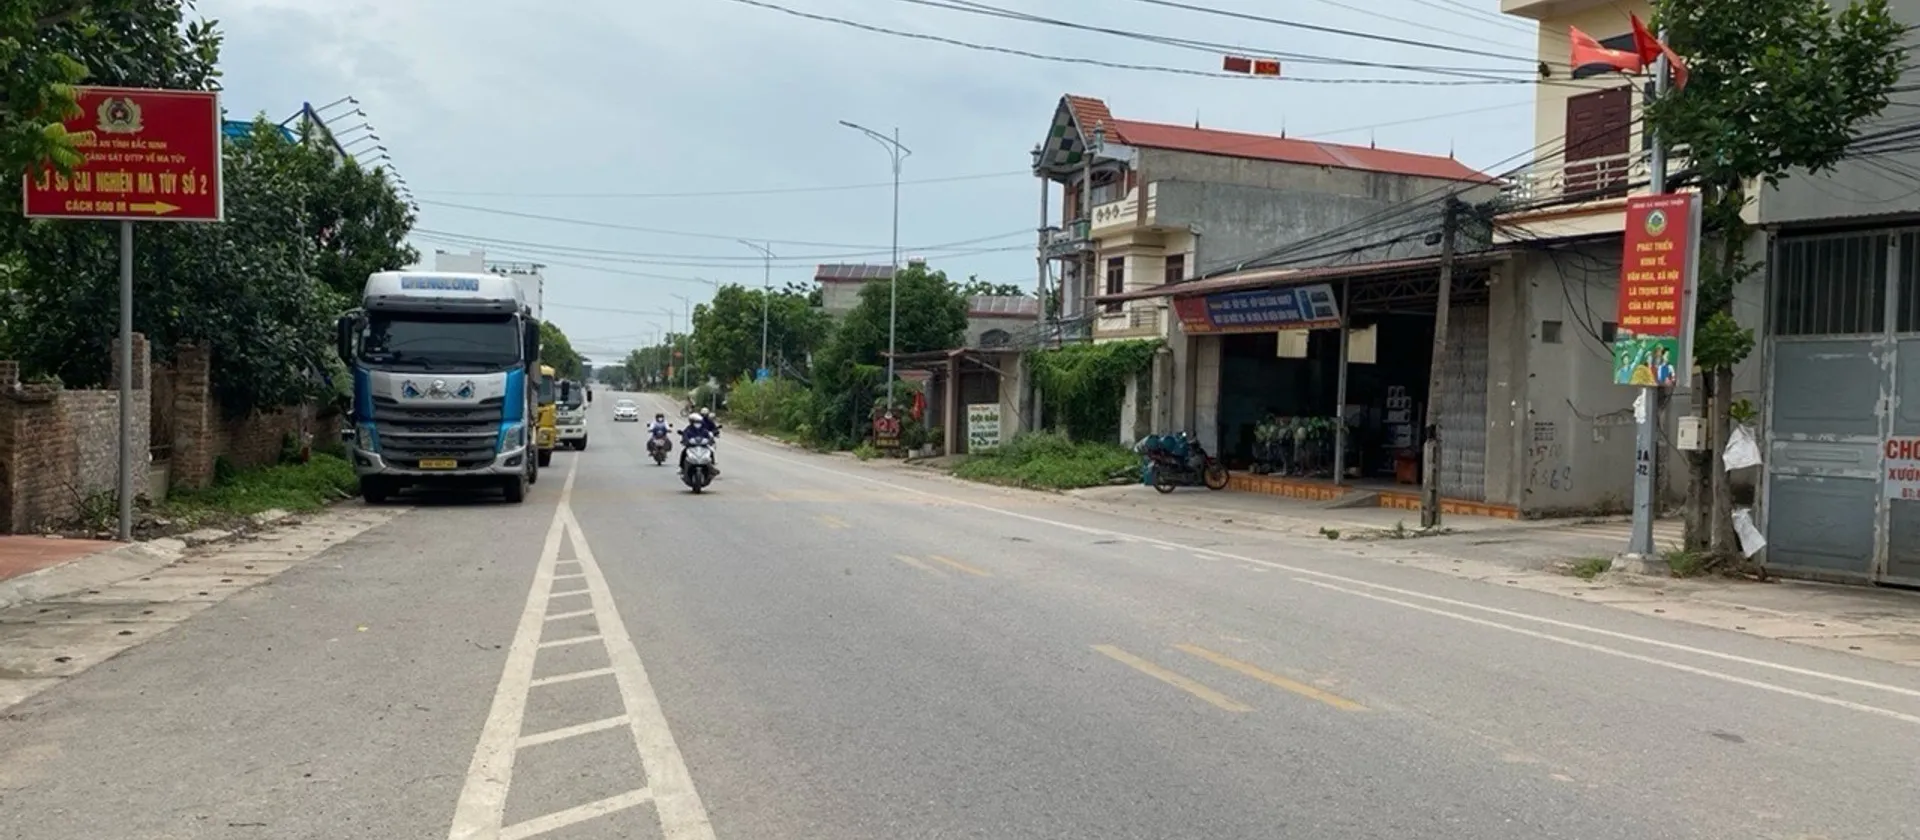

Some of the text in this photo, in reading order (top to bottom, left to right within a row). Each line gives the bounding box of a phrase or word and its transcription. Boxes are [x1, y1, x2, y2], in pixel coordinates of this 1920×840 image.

[99, 140, 111, 148] AN
[131, 137, 147, 149] BẮC
[156, 154, 170, 163] MA
[74, 171, 91, 192] CAI
[96, 168, 133, 197] NGHIỆN
[138, 172, 155, 194] MA
[182, 167, 196, 195] SỐ
[200, 174, 208, 195] 2
[65, 199, 93, 212] CÁCH
[95, 201, 114, 212] 500
